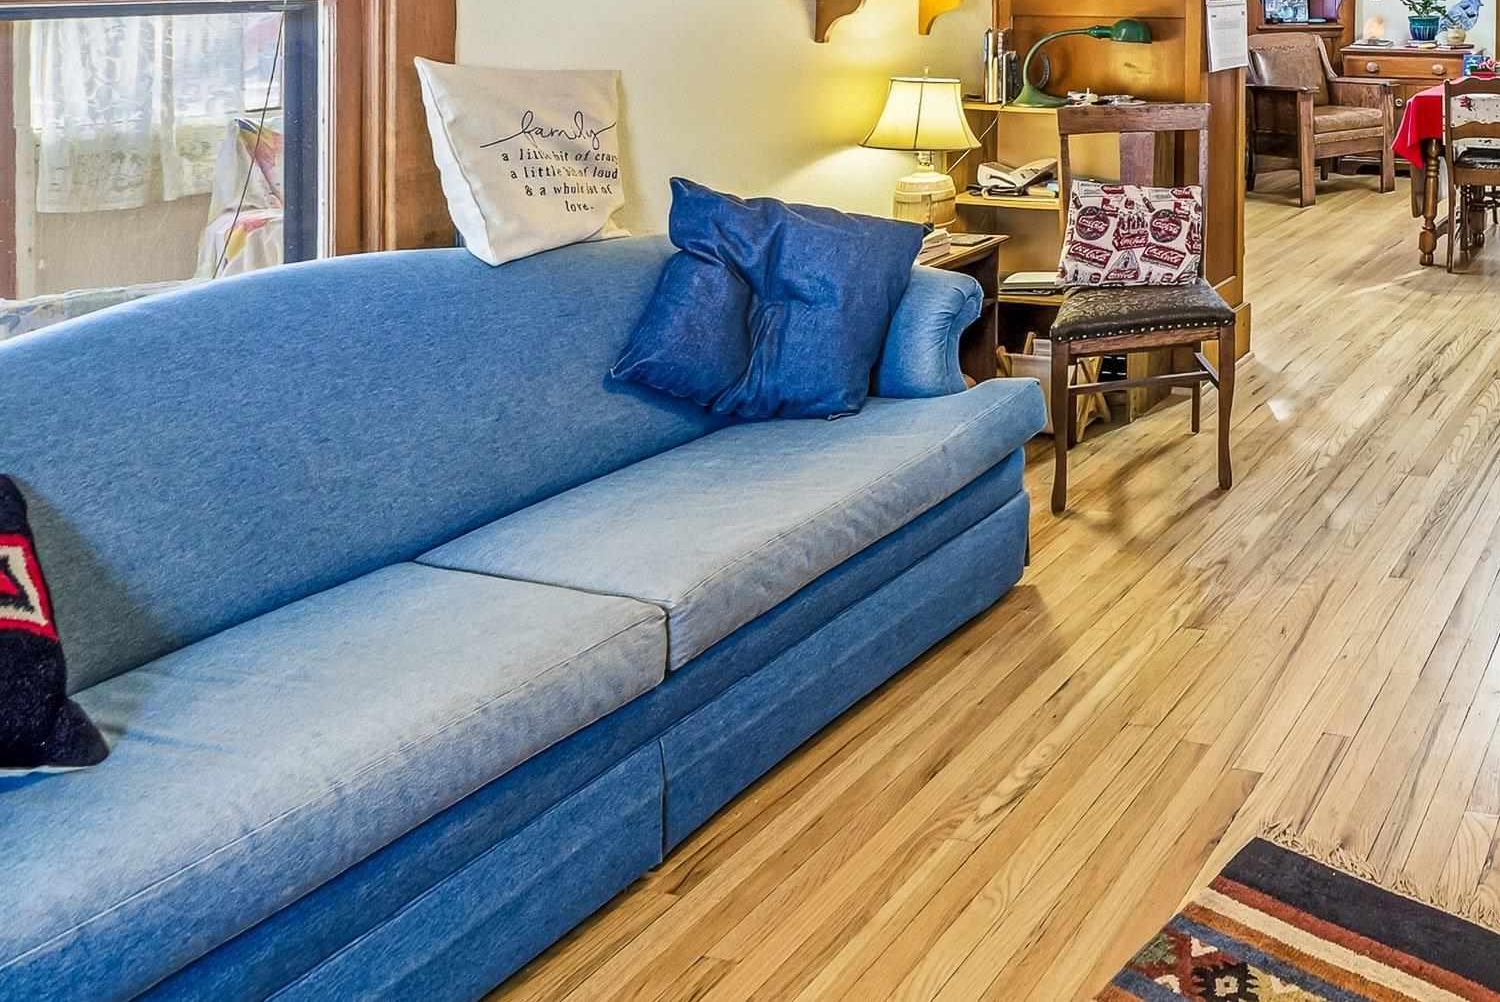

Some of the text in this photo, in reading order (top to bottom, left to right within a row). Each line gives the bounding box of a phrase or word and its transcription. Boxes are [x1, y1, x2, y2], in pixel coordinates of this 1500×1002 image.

[479, 110, 617, 150] family
[501, 152, 510, 162] a
[575, 150, 591, 162] of
[510, 170, 518, 179] a
[523, 165, 561, 178] little
[592, 166, 618, 179] loud
[539, 186, 546, 196] a
[600, 184, 613, 194] of
